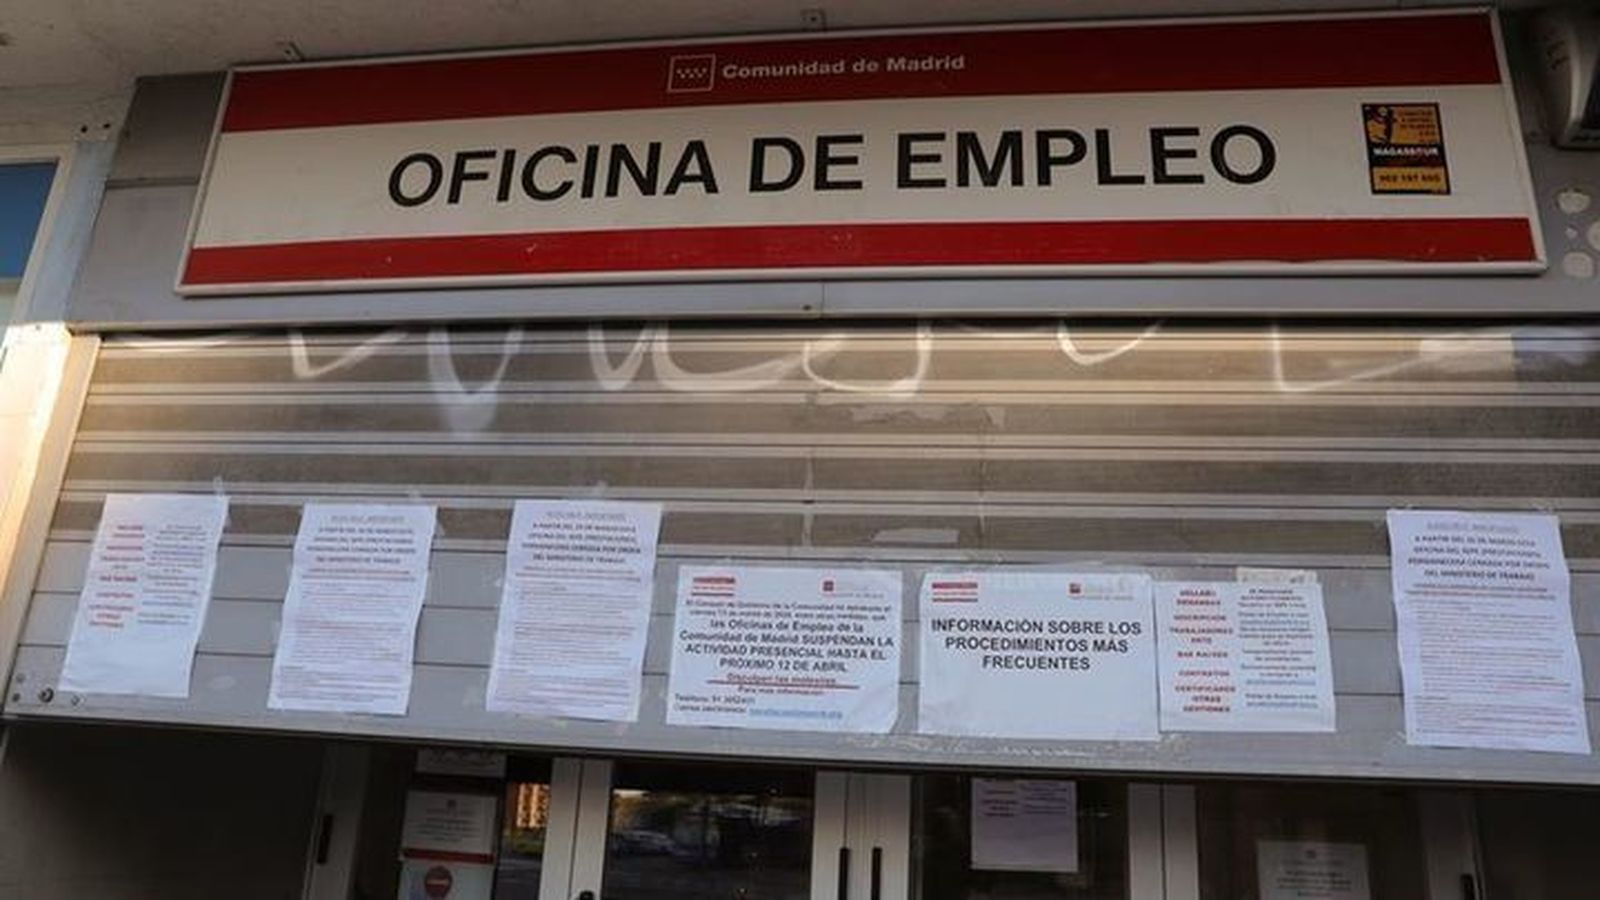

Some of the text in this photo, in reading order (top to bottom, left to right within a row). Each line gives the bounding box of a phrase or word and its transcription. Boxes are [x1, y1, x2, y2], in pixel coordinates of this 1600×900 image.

[722, 55, 966, 80] Comunidad de Madrid
[388, 124, 1277, 207] OFICINA DE EMPLEO
[728, 619, 773, 630] Oficinas
[776, 620, 788, 630] de
[792, 620, 834, 632] Empleo
[837, 621, 850, 632] de
[853, 622, 864, 632] la
[1048, 621, 1103, 634] SOBRE
[1108, 622, 1142, 635] LOS
[679, 630, 894, 647] Comunidad de Madrid SUSPENDAN LA
[945, 637, 1129, 653] PROCEDIMIENTOS MÁS
[685, 643, 886, 660] ACTIVIDAD PRESENCIAL HASTA EL
[778, 660, 789, 670] 12
[793, 661, 808, 671] DE
[813, 661, 848, 672] ABRIL
[982, 655, 1090, 670] FRECUENTES
